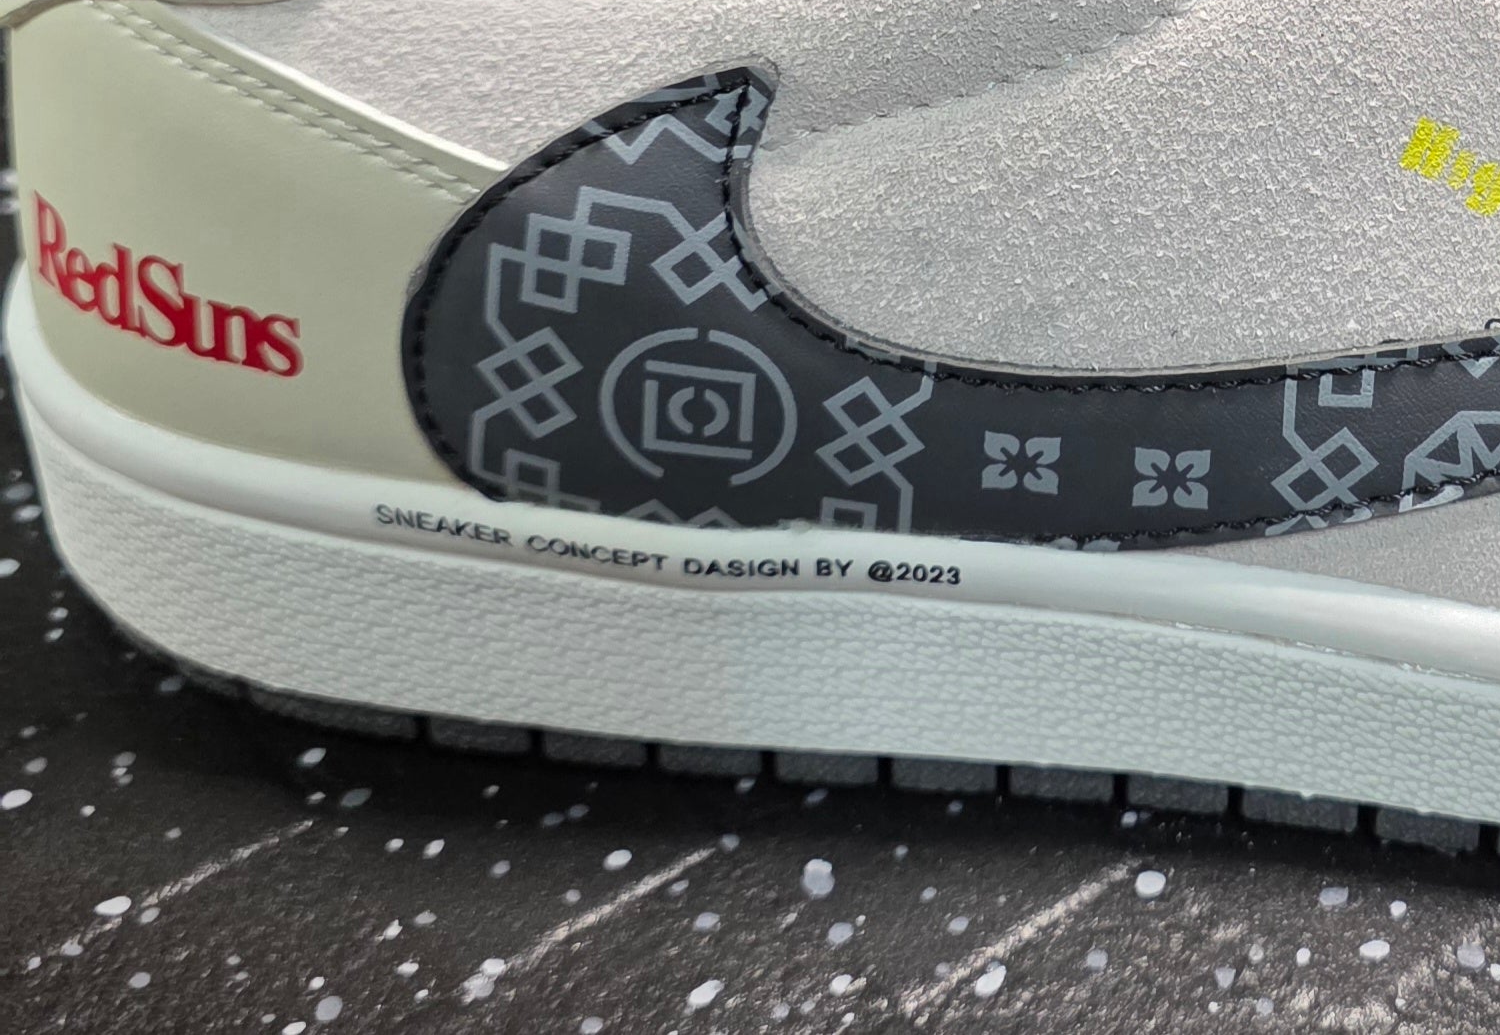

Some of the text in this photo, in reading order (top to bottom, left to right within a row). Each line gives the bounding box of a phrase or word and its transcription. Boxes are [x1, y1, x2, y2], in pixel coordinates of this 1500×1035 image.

[34, 190, 304, 378] RedSuns
[375, 504, 962, 586] SNEAKER CONCEPT DASIGN BY @2023
